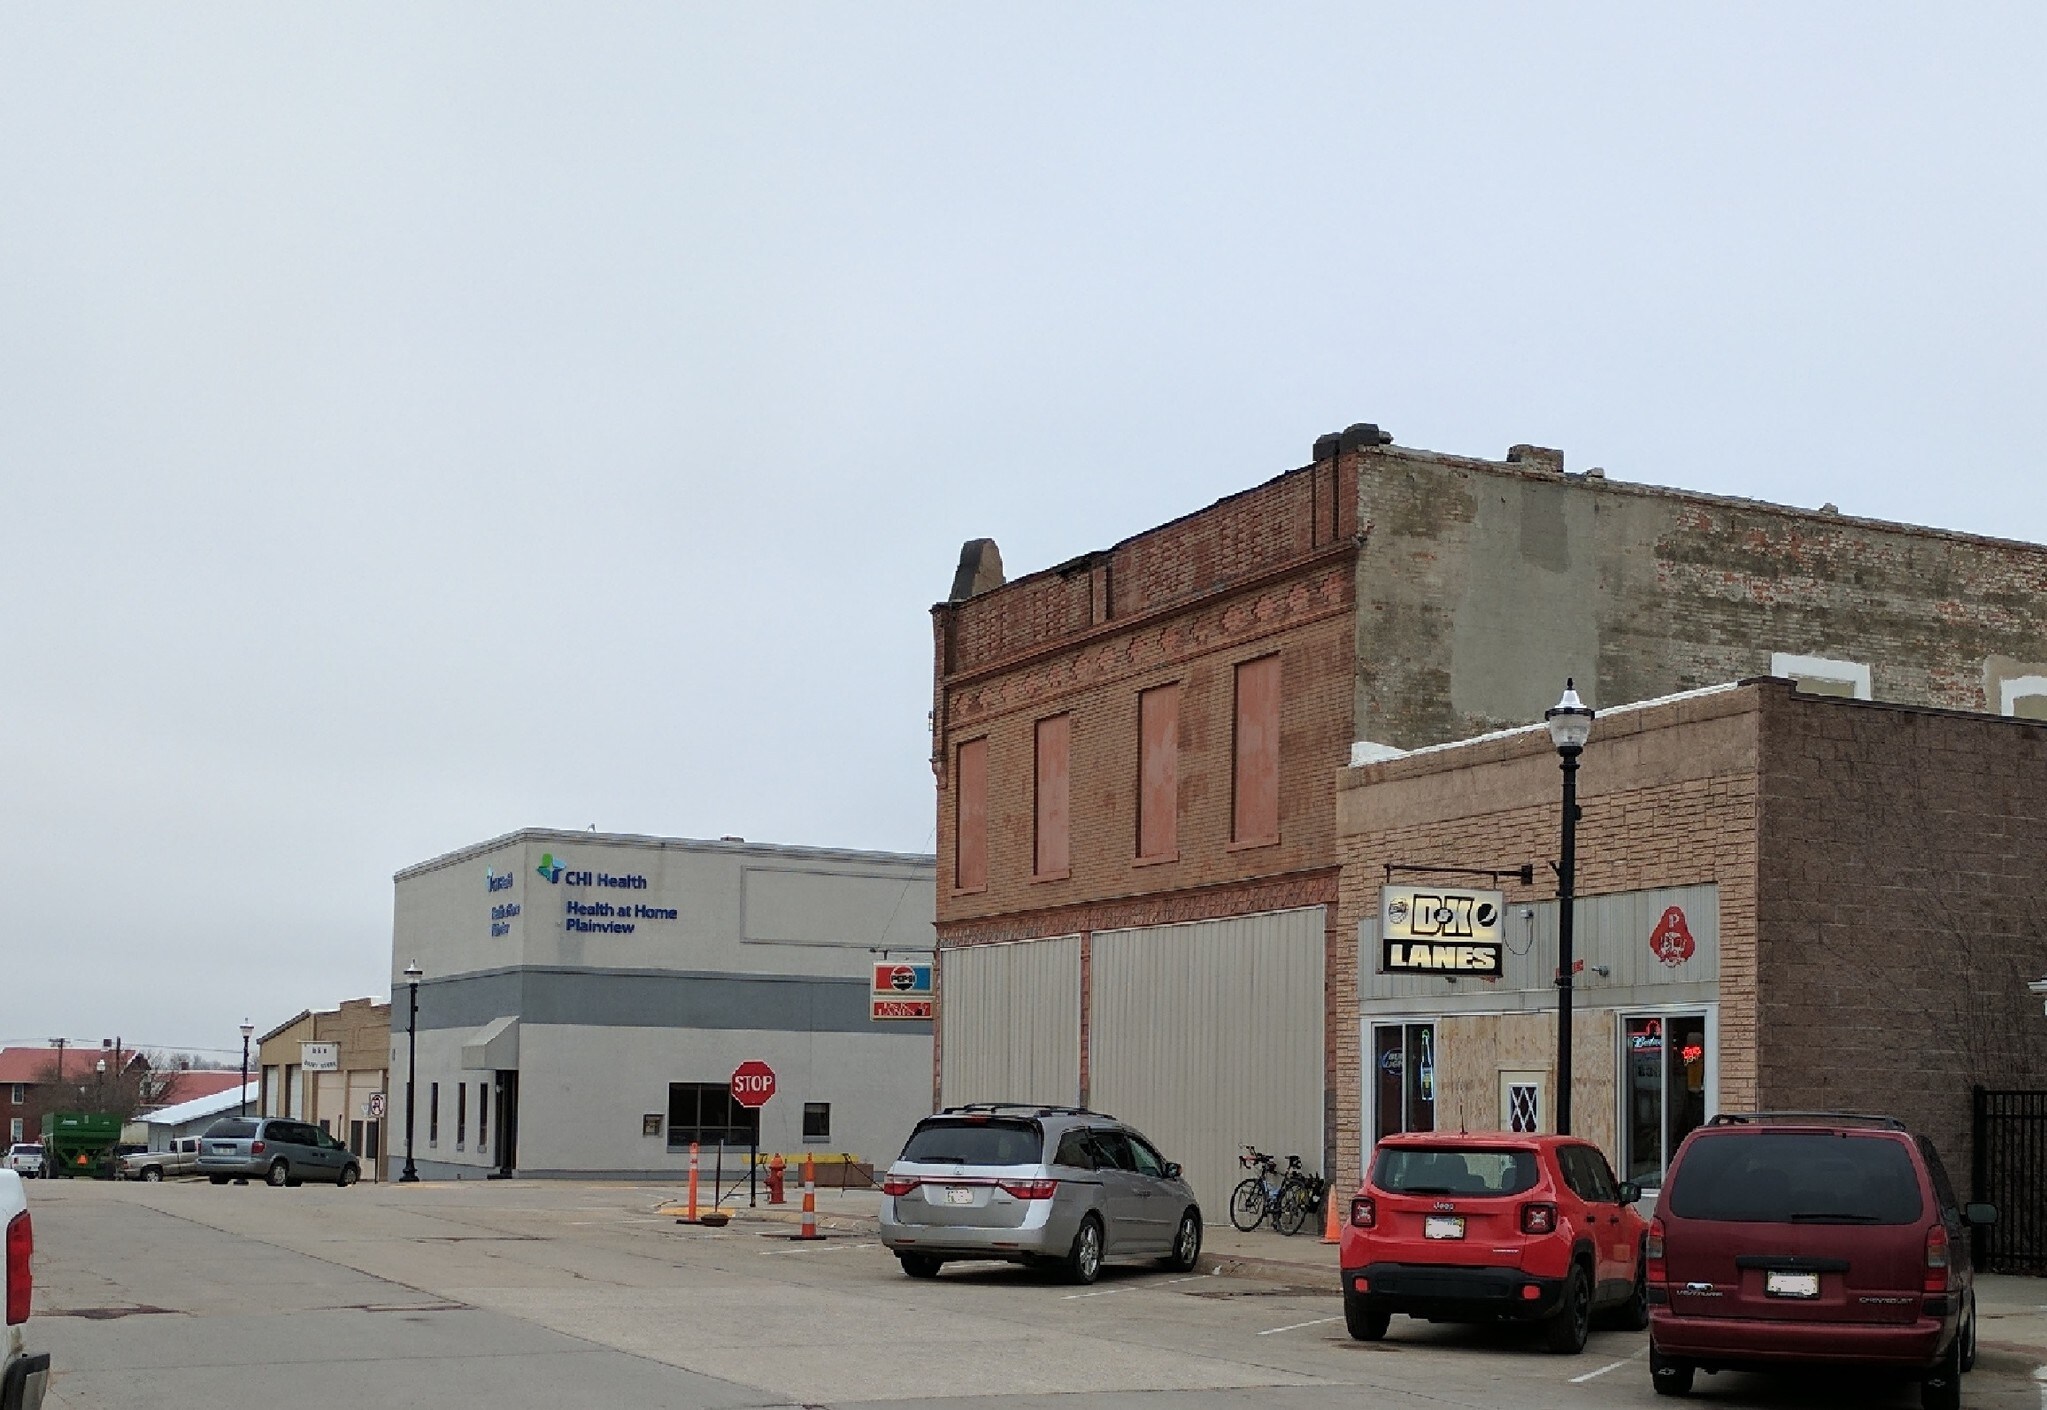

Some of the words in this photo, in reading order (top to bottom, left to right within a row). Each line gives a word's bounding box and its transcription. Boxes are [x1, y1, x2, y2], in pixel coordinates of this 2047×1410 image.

[565, 871, 592, 887] CHI
[597, 873, 647, 889] Health
[566, 901, 614, 917] Health
[616, 904, 632, 918] at
[635, 905, 678, 920] Home
[566, 918, 635, 934] Plainview
[1390, 943, 1496, 969] LANES
[734, 1075, 773, 1092] STOP
[1433, 1201, 1454, 1211] Jeep
